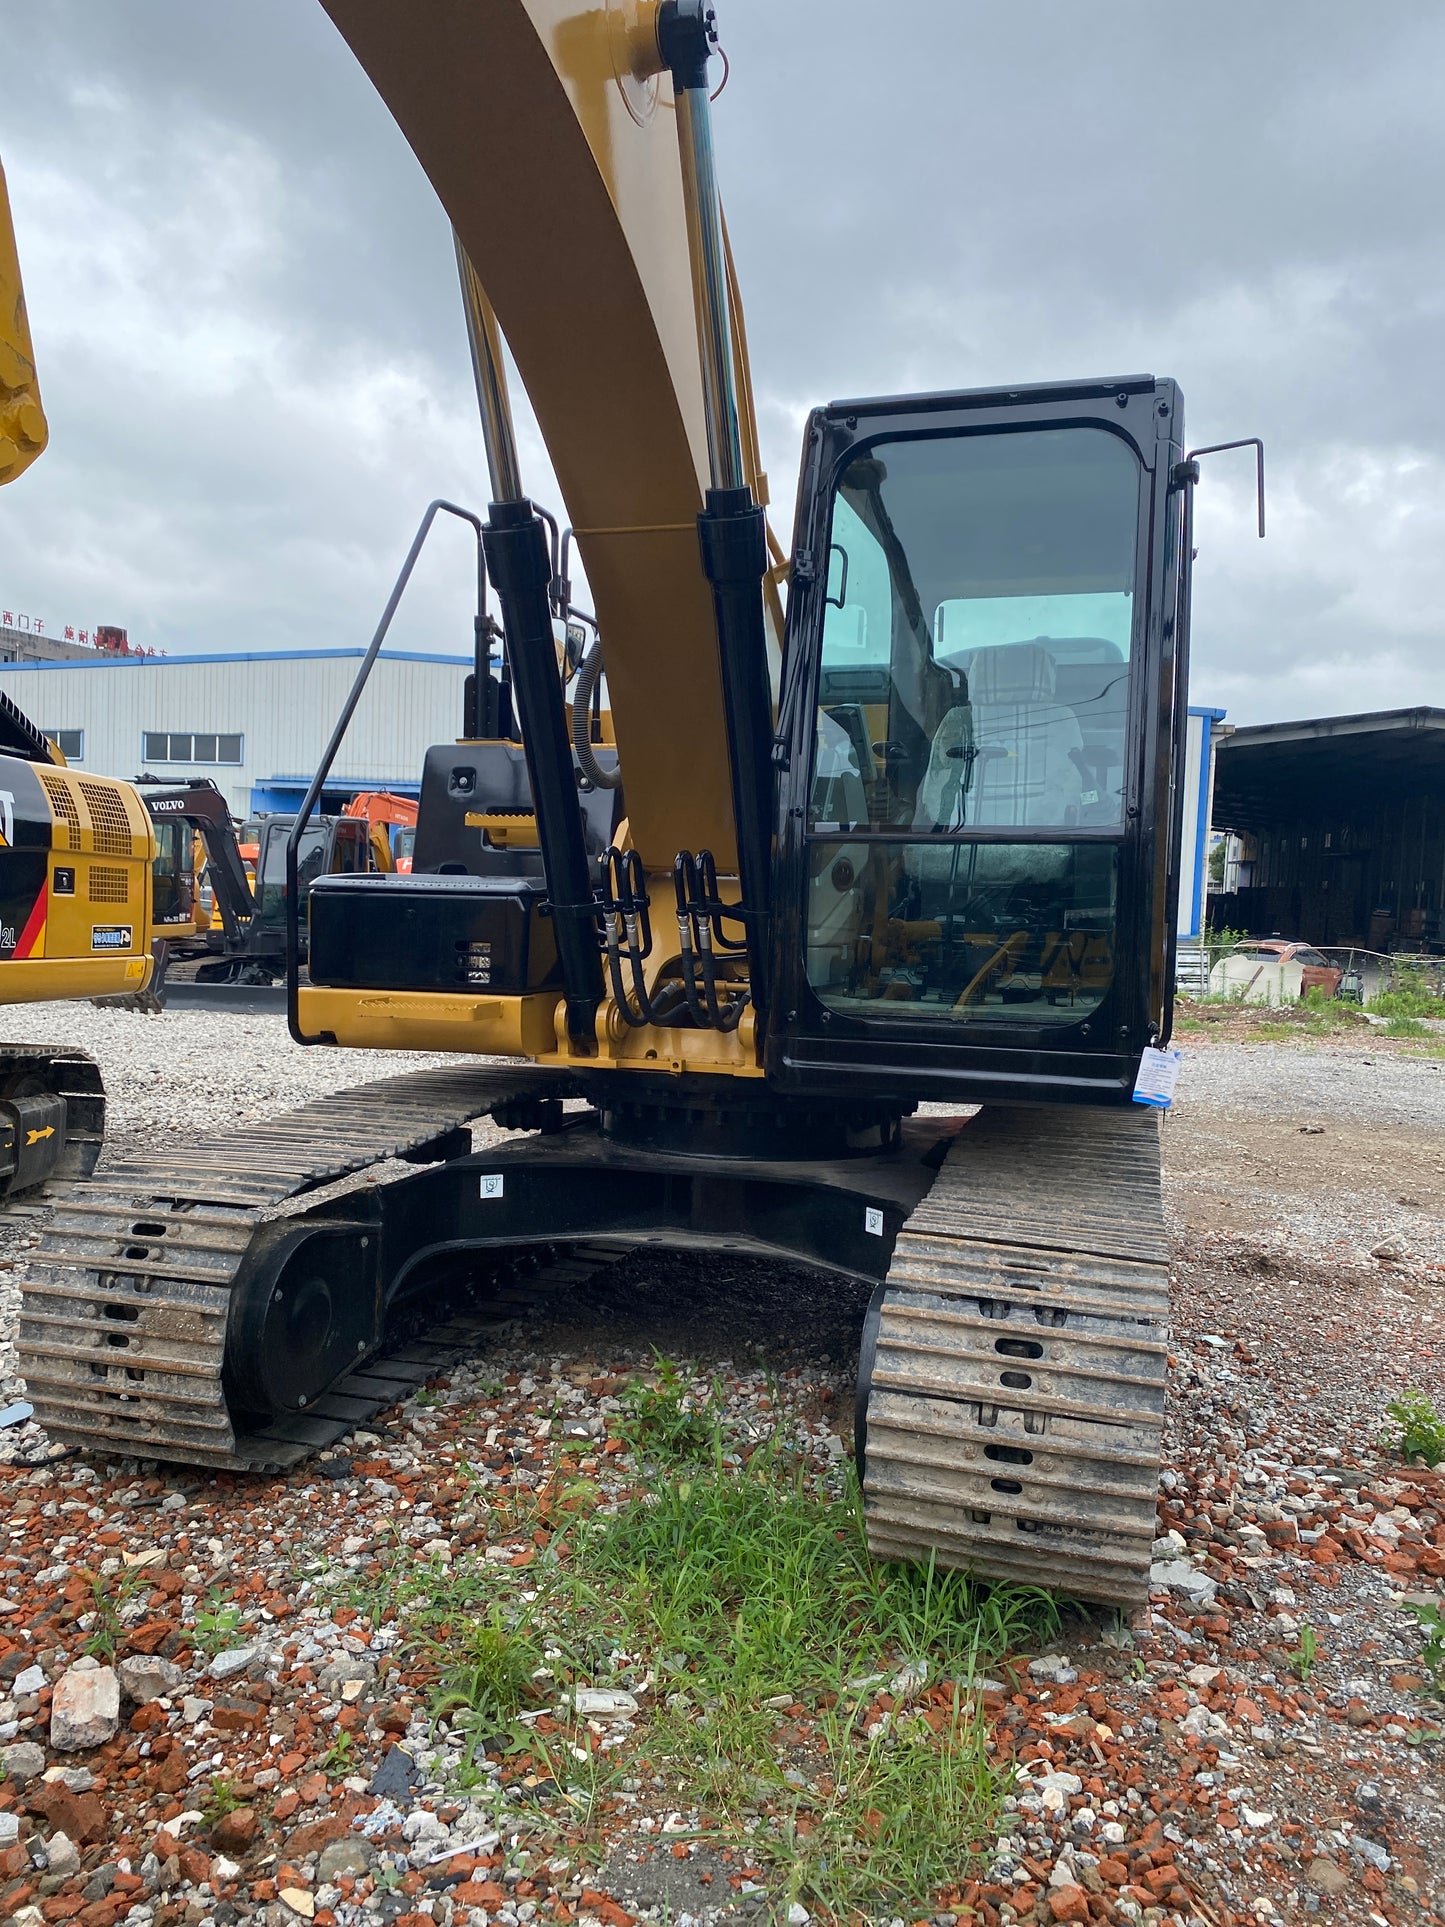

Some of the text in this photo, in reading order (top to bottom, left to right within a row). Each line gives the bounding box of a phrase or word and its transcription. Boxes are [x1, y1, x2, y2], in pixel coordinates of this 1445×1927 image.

[3, 610, 45, 632] 西门子
[151, 800, 184, 811] VOLVO
[0, 919, 17, 948] 2L
